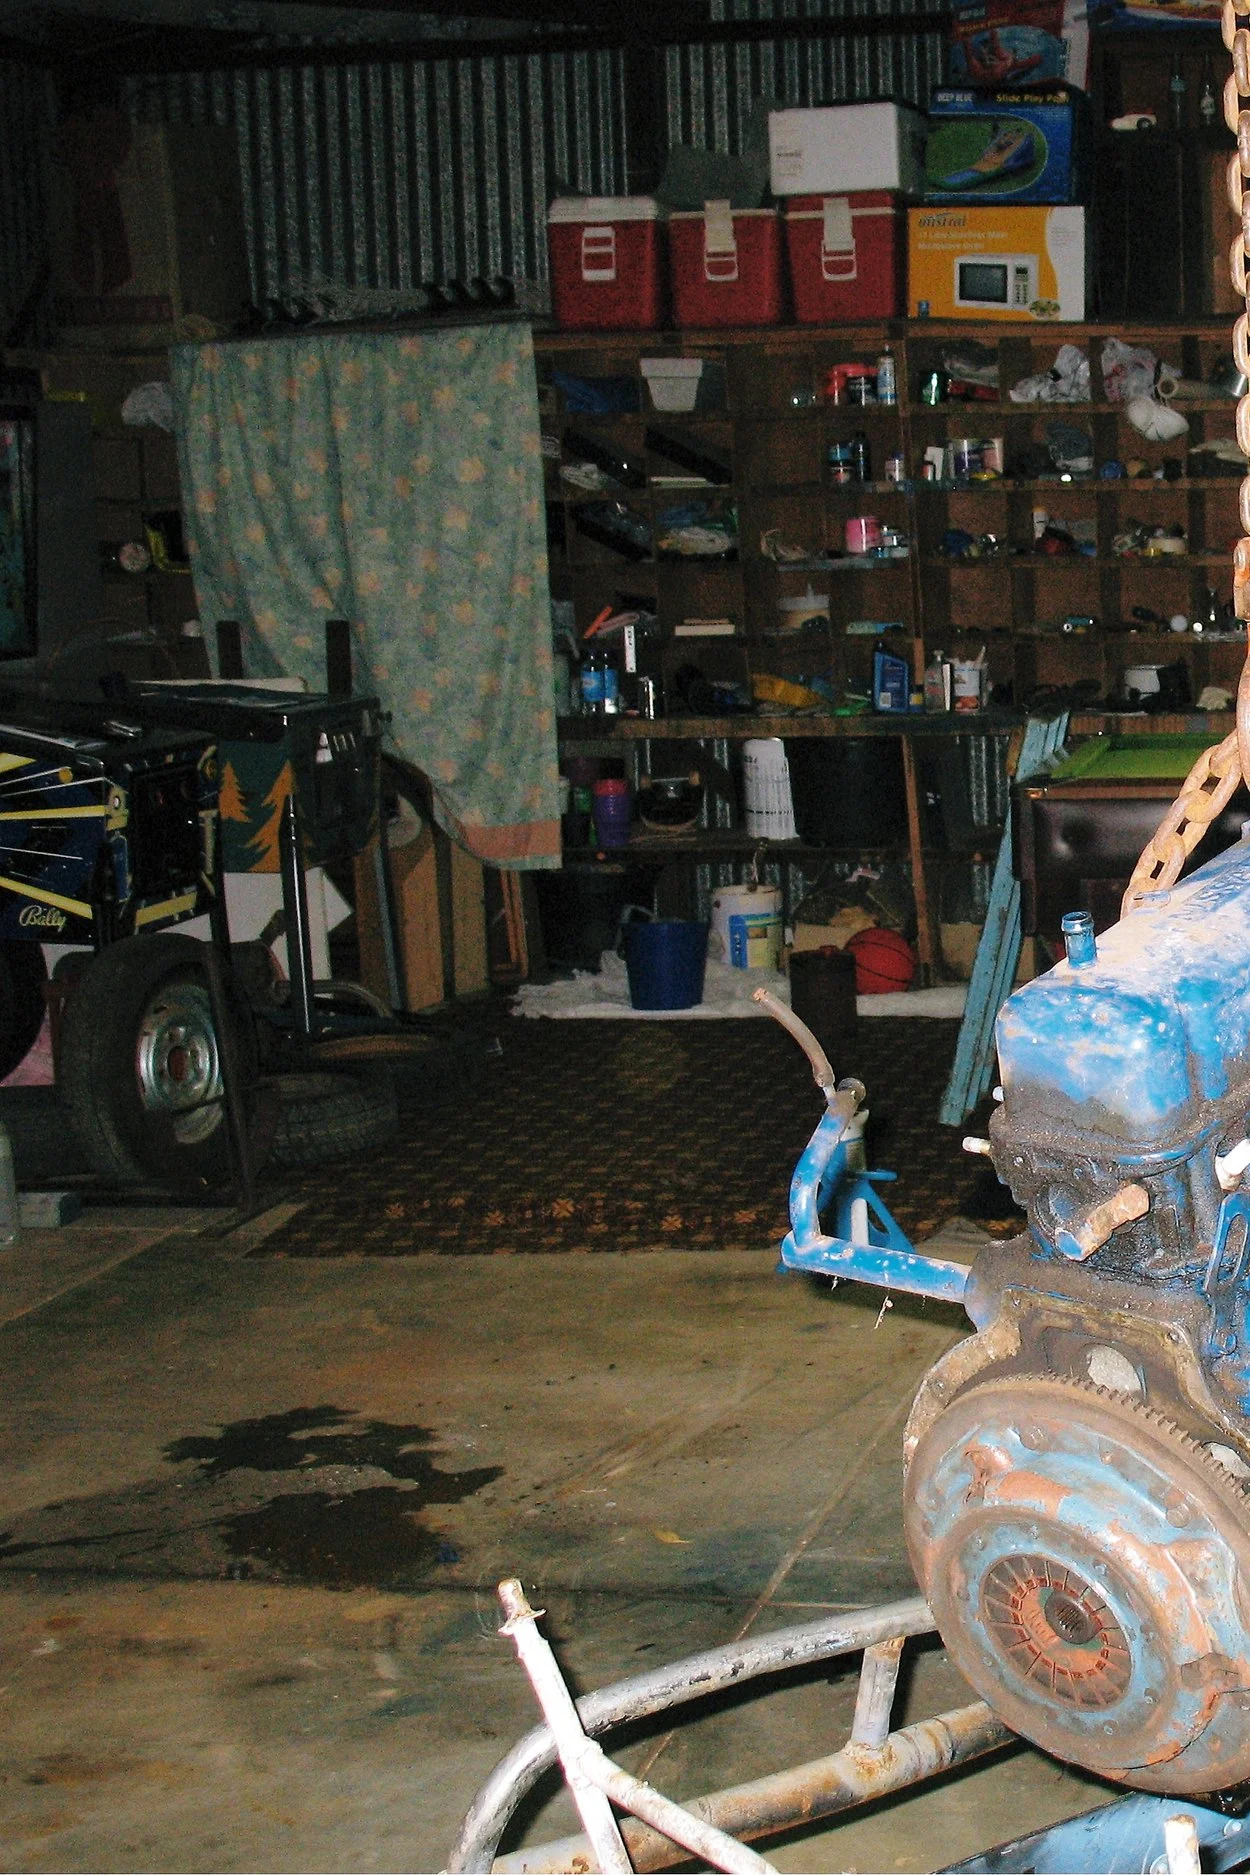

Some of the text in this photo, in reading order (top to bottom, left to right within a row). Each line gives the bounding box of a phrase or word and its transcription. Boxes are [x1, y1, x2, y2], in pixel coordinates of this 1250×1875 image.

[1023, 93, 1044, 104] Play
[918, 211, 967, 228] mistral
[19, 905, 66, 932] Bally
